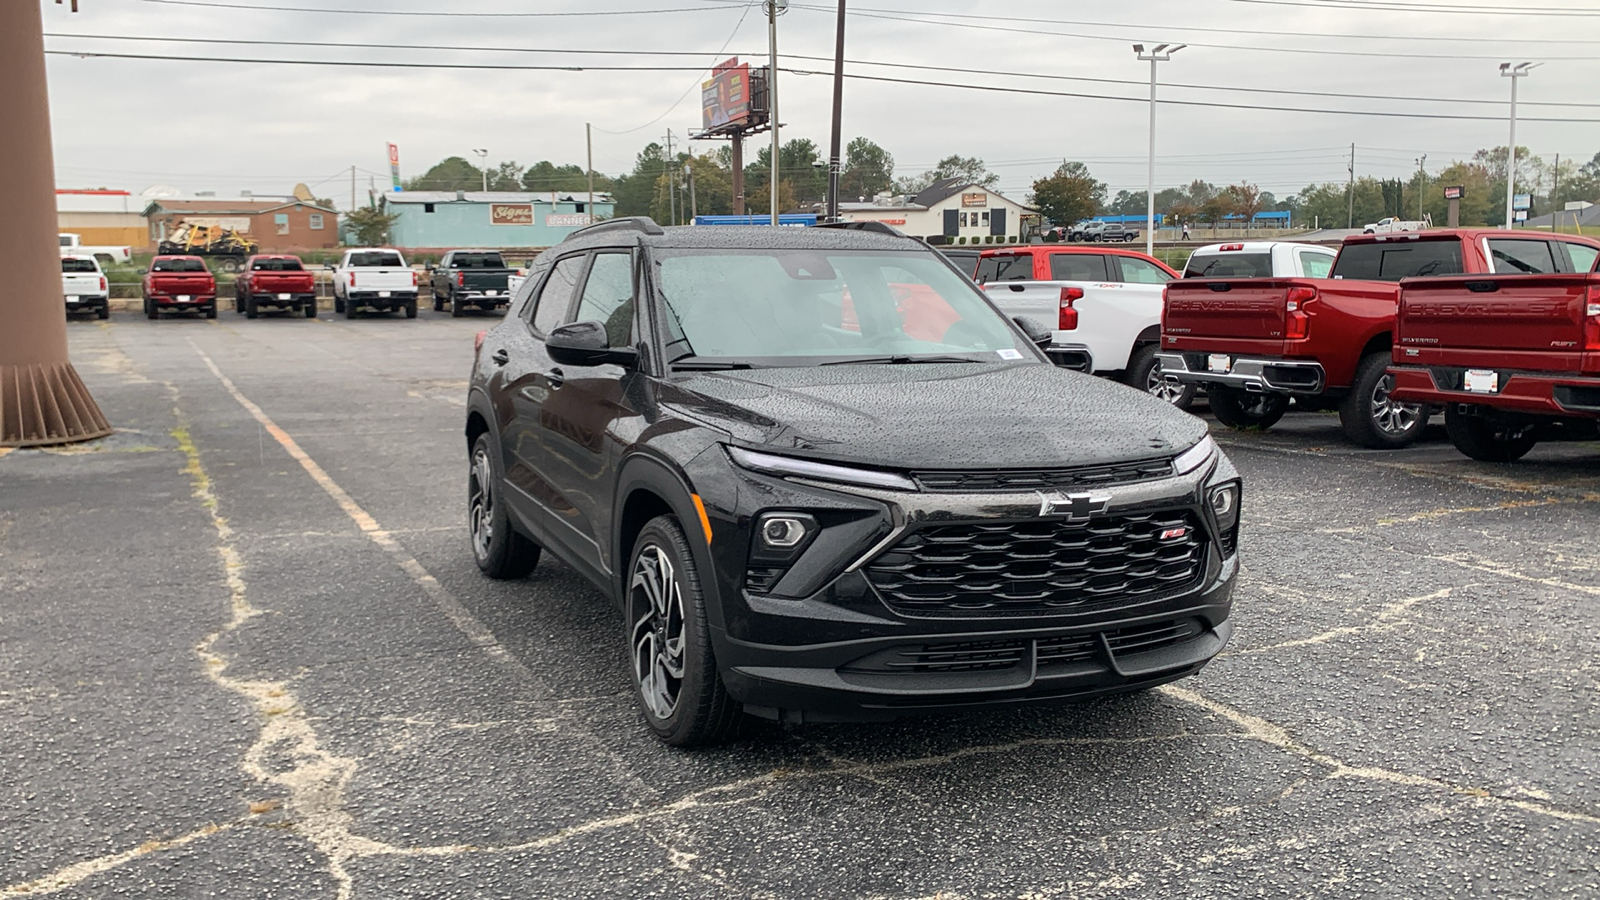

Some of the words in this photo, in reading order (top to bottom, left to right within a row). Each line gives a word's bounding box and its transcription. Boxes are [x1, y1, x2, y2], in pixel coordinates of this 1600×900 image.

[1170, 300, 1274, 312] CHEVROLET
[1408, 303, 1567, 316] CHEVROLET
[1160, 528, 1186, 539] RS
